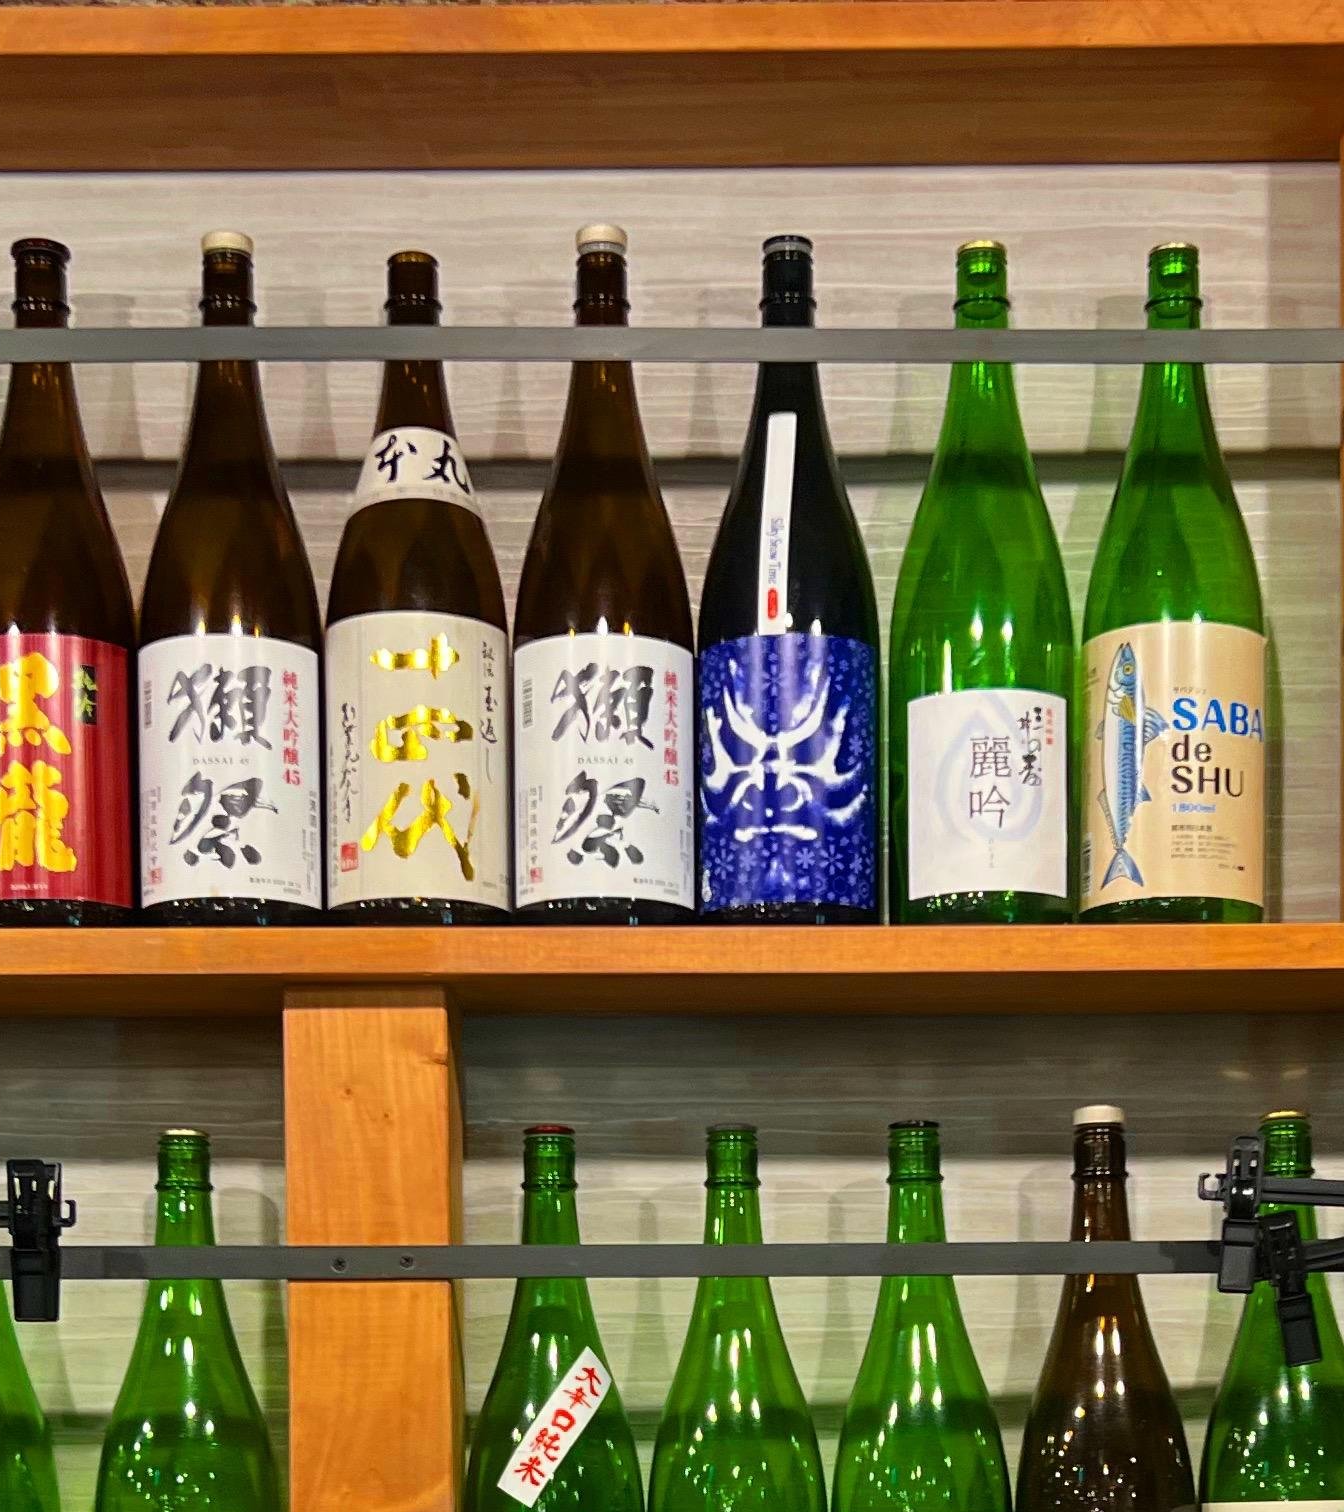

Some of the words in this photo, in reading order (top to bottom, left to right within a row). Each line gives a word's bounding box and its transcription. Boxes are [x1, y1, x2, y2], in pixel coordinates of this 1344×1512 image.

[167, 663, 279, 869] 獺祭
[281, 669, 301, 786] 純米大吟醸45
[359, 632, 475, 881] 十四代
[551, 663, 659, 869] 獺祭
[663, 670, 680, 786] 純米大吟醸45
[1171, 697, 1264, 743] SABA
[1171, 735, 1212, 764] de
[968, 734, 1013, 829] 麗吟
[1171, 766, 1244, 799] SHU
[513, 1364, 604, 1488] 大辛口純米
